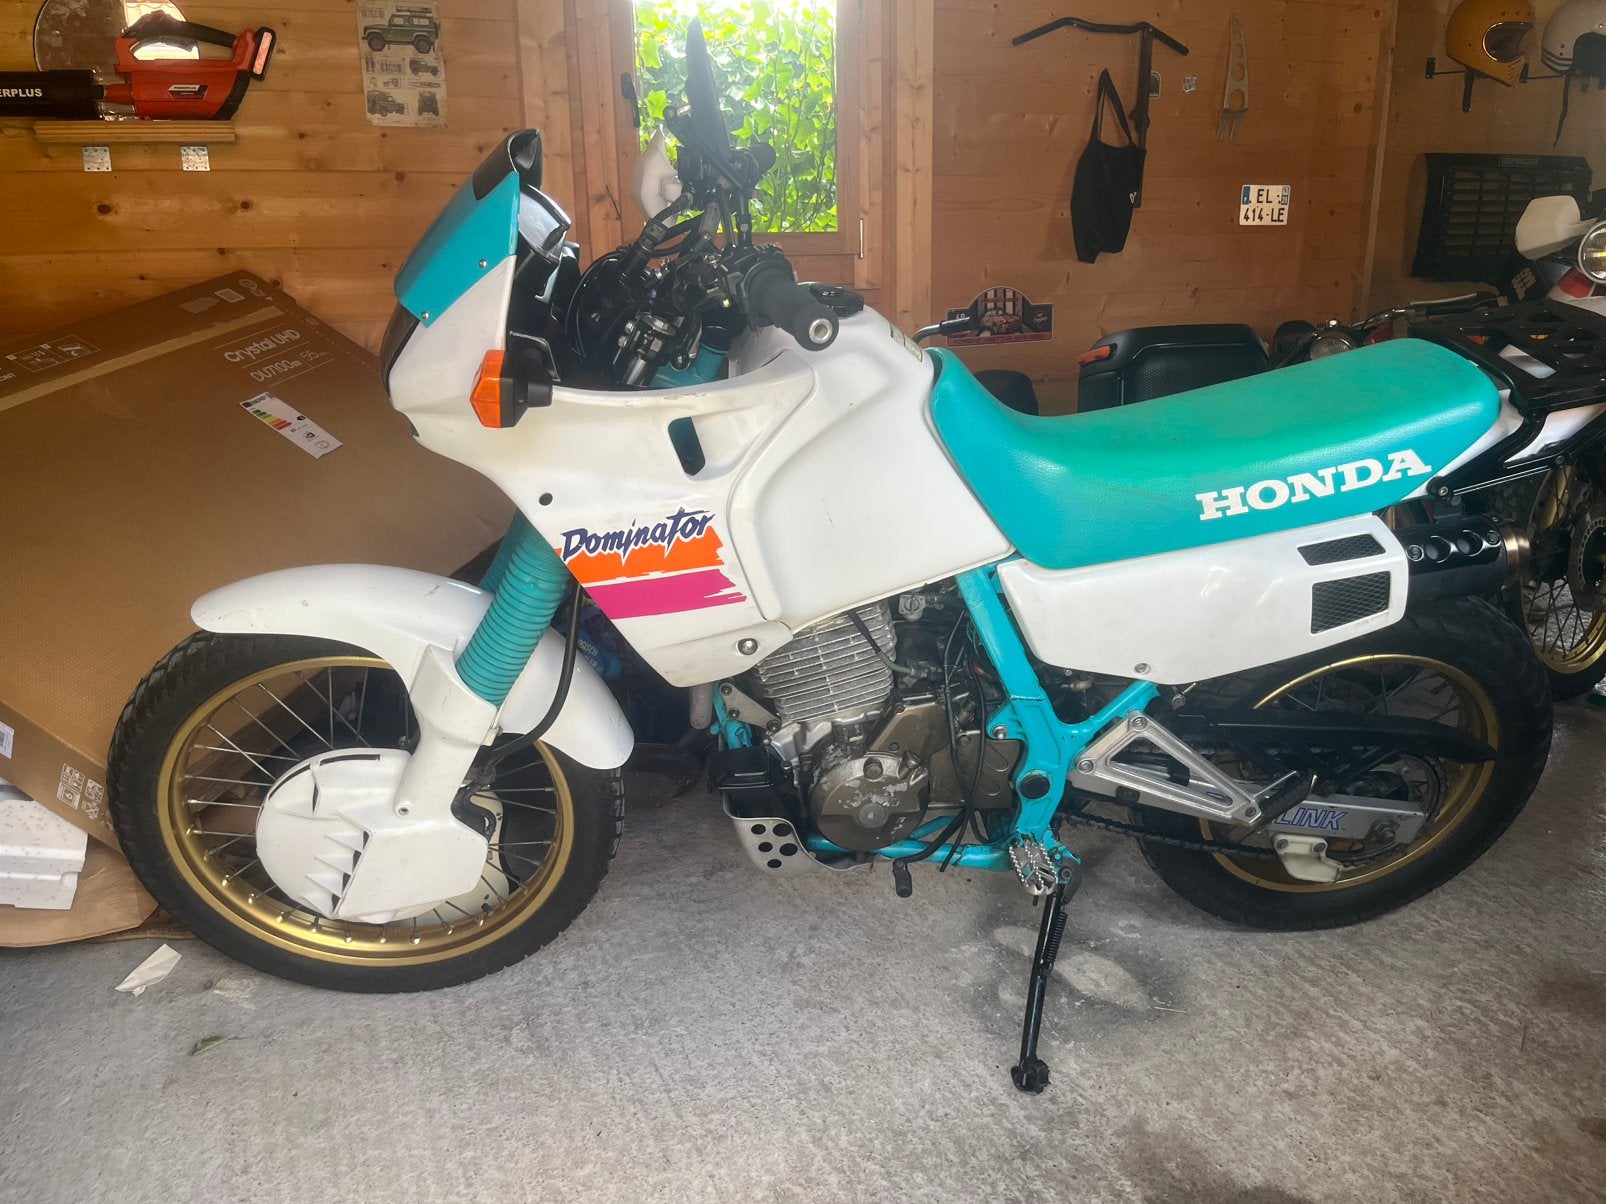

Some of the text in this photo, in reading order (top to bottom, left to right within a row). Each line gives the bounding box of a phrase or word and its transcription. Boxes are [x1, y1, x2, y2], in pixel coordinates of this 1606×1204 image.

[223, 329, 301, 362] Crystal UHD
[1196, 449, 1433, 521] HONDA
[560, 506, 717, 564] Dominator
[1275, 807, 1348, 831] LINK
